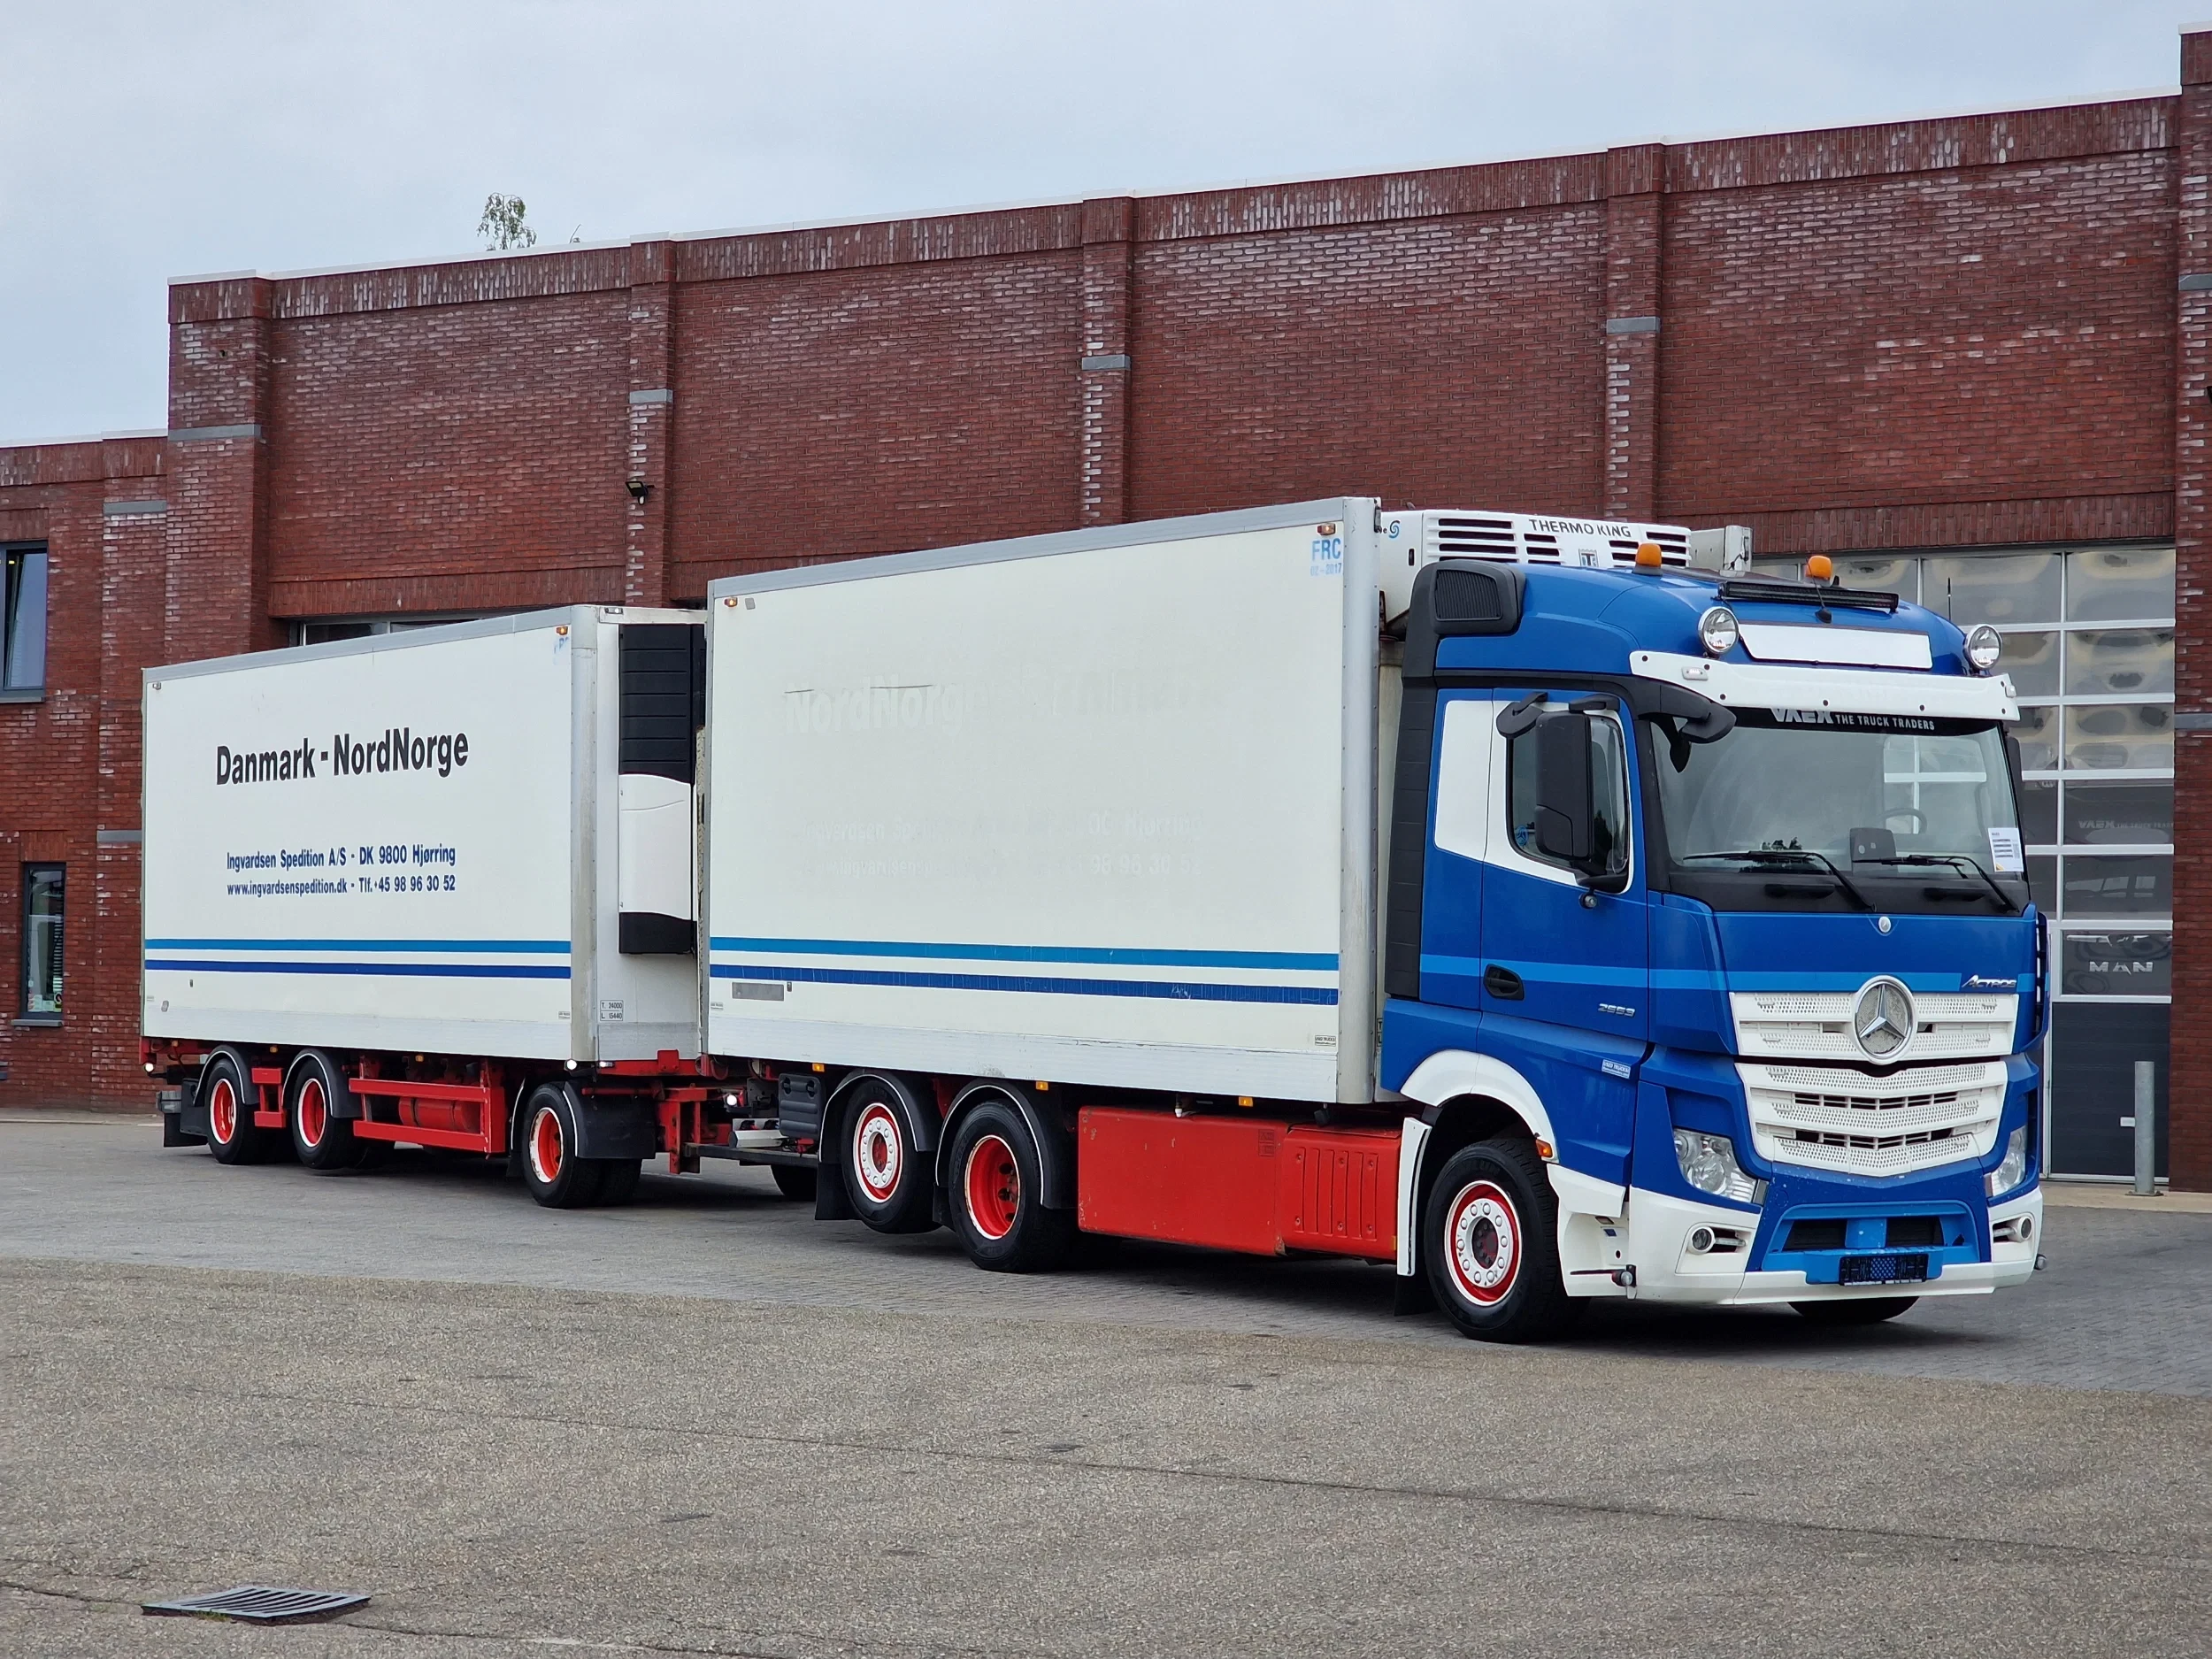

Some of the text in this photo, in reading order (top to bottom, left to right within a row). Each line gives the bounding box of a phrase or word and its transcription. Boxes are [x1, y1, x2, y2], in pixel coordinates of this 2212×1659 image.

[1529, 518, 1632, 537] THERMO KING
[1312, 538, 1341, 561] FRC
[1835, 714, 1855, 725] THE
[1857, 715, 1890, 727] TRUCK
[1892, 717, 1935, 731] TRADERS
[217, 737, 316, 785] Danmark
[334, 726, 469, 779] NordNorge
[227, 850, 277, 873] Ingvardsen
[280, 848, 325, 872] Spedition
[328, 847, 347, 867] A/S
[359, 846, 374, 865] DK
[379, 844, 407, 864] 9800
[412, 842, 456, 868] Hjørring
[227, 878, 348, 898] www.ingvardsenspedition.dk
[394, 875, 407, 893] 98
[410, 875, 423, 892] 96
[426, 874, 440, 892] 30
[443, 874, 456, 892] 52
[2089, 961, 2154, 975] MAN
[1598, 1002, 1636, 1018] 2553
